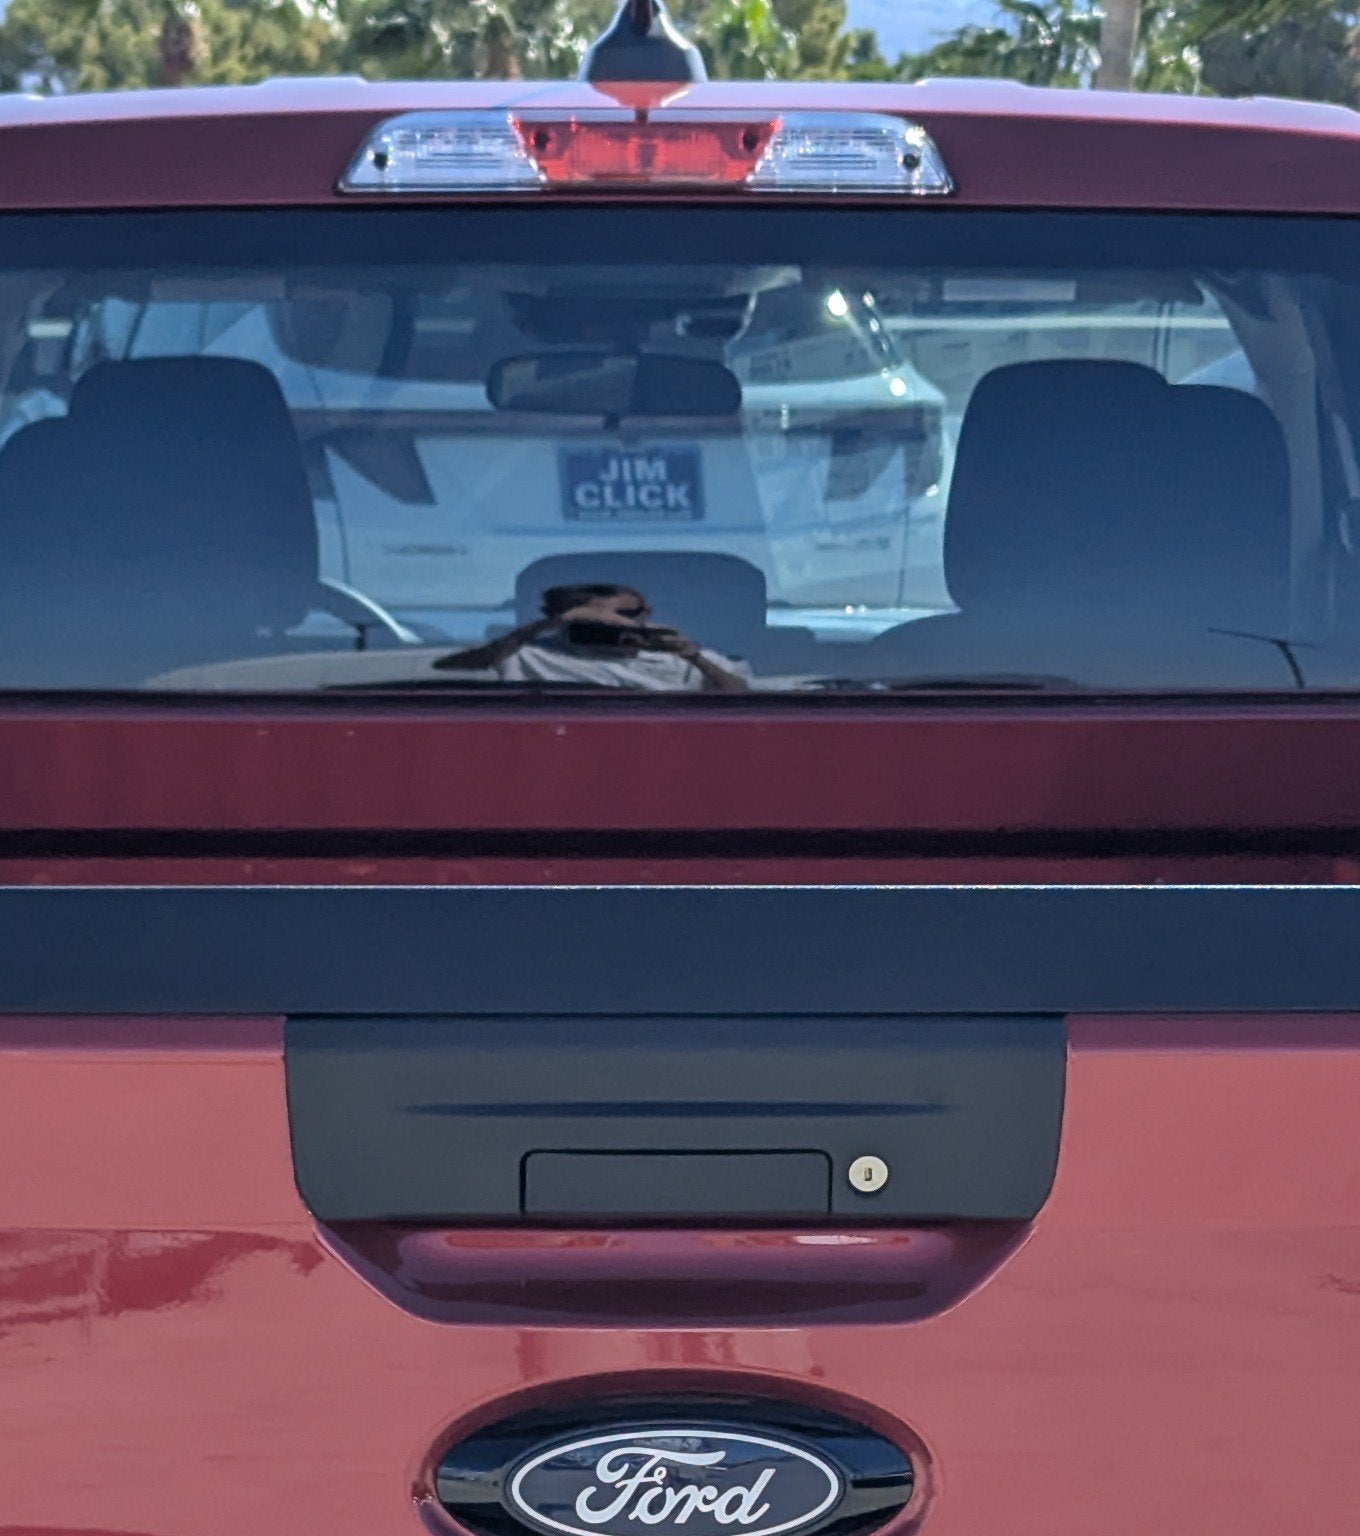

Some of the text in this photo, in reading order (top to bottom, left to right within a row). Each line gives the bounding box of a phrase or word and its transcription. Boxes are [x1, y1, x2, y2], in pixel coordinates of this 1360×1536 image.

[598, 457, 667, 483] JIM
[575, 483, 691, 508] CLICK
[575, 1446, 776, 1526] Ford
